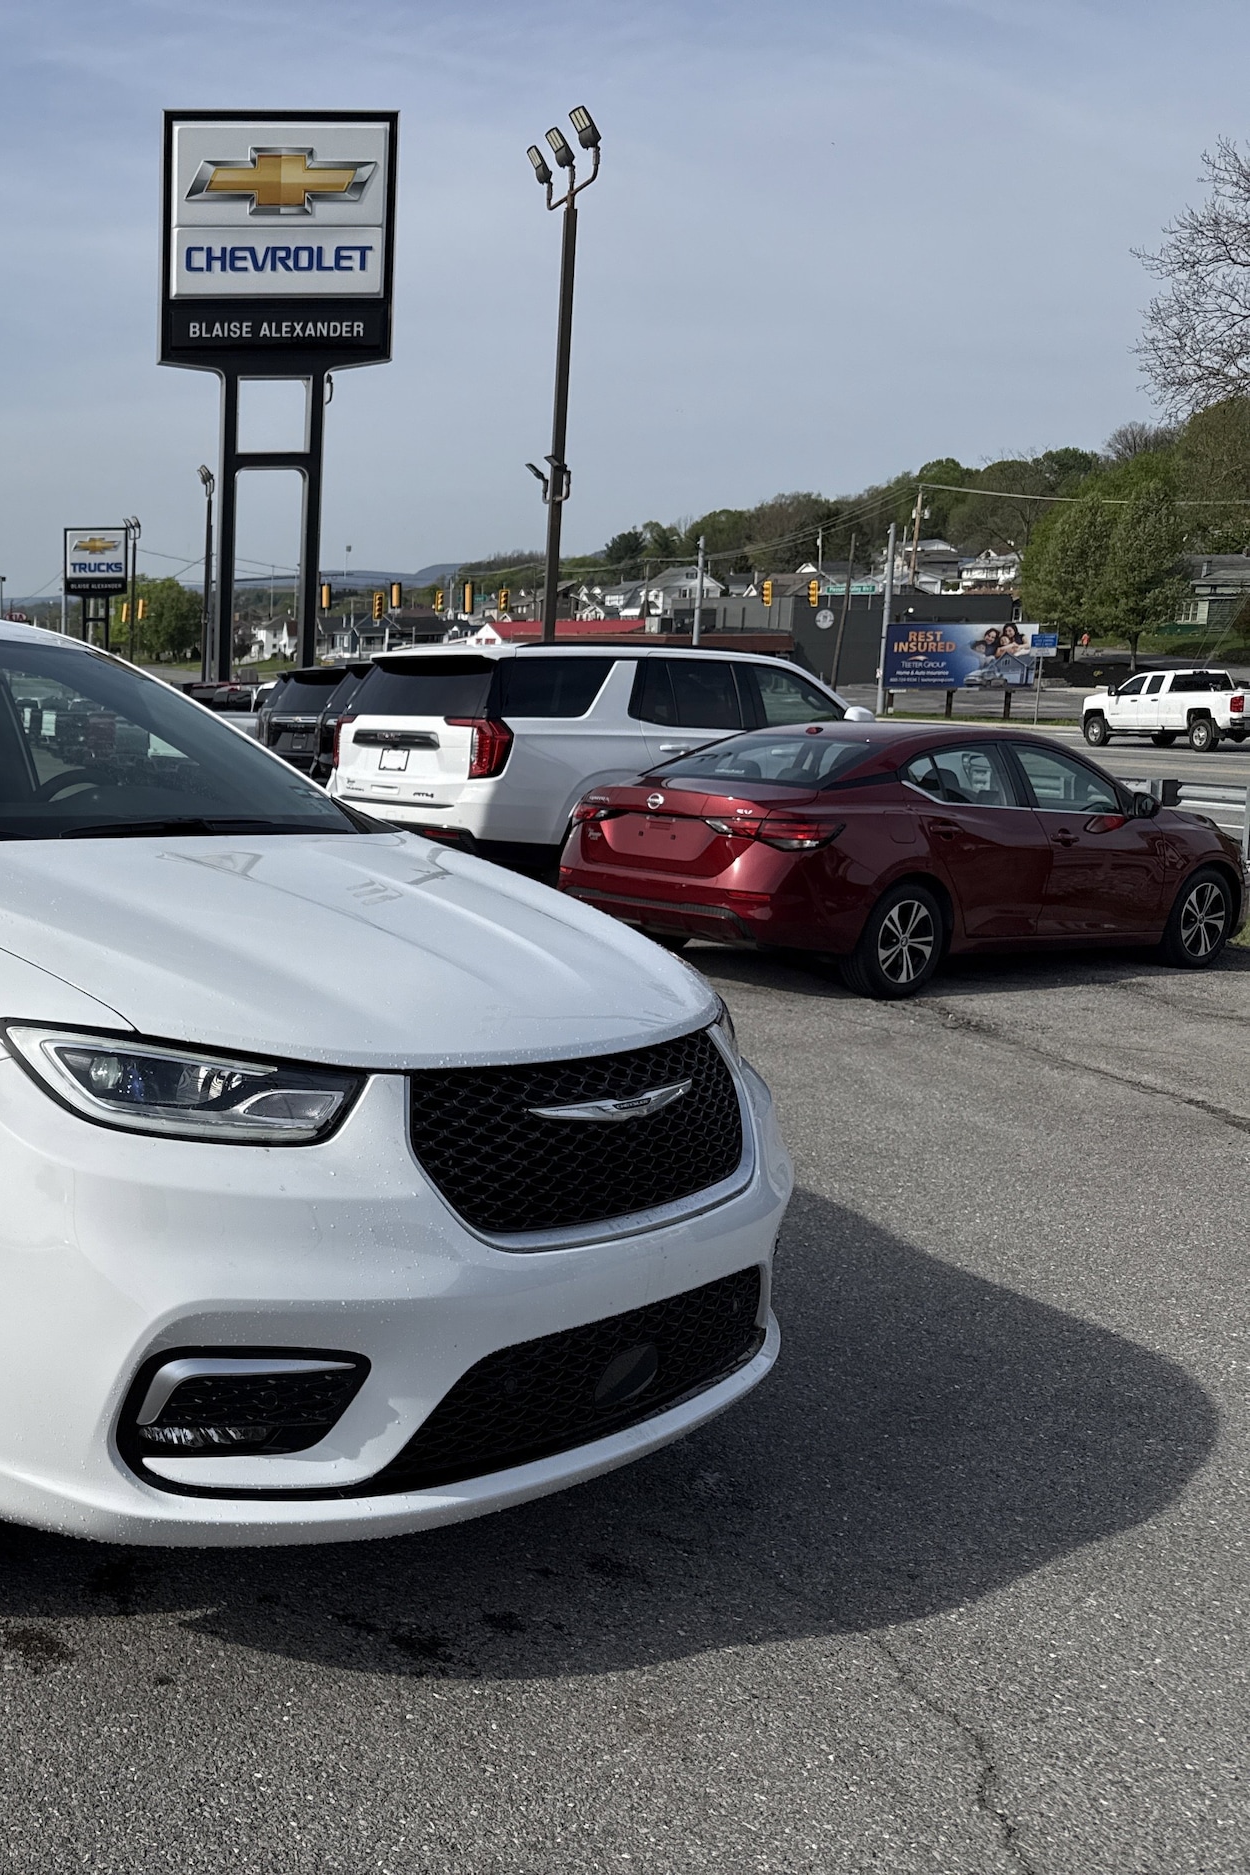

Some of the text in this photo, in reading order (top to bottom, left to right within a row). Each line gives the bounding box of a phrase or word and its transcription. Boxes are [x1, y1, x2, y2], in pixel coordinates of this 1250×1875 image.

[185, 246, 373, 272] CHEVROLET
[189, 322, 364, 338] BLAISE ALEXANDER
[70, 562, 123, 573] TRUCKS
[908, 631, 943, 642] REST
[893, 641, 957, 653] INSURED
[615, 1099, 650, 1110] CHRYSLER
